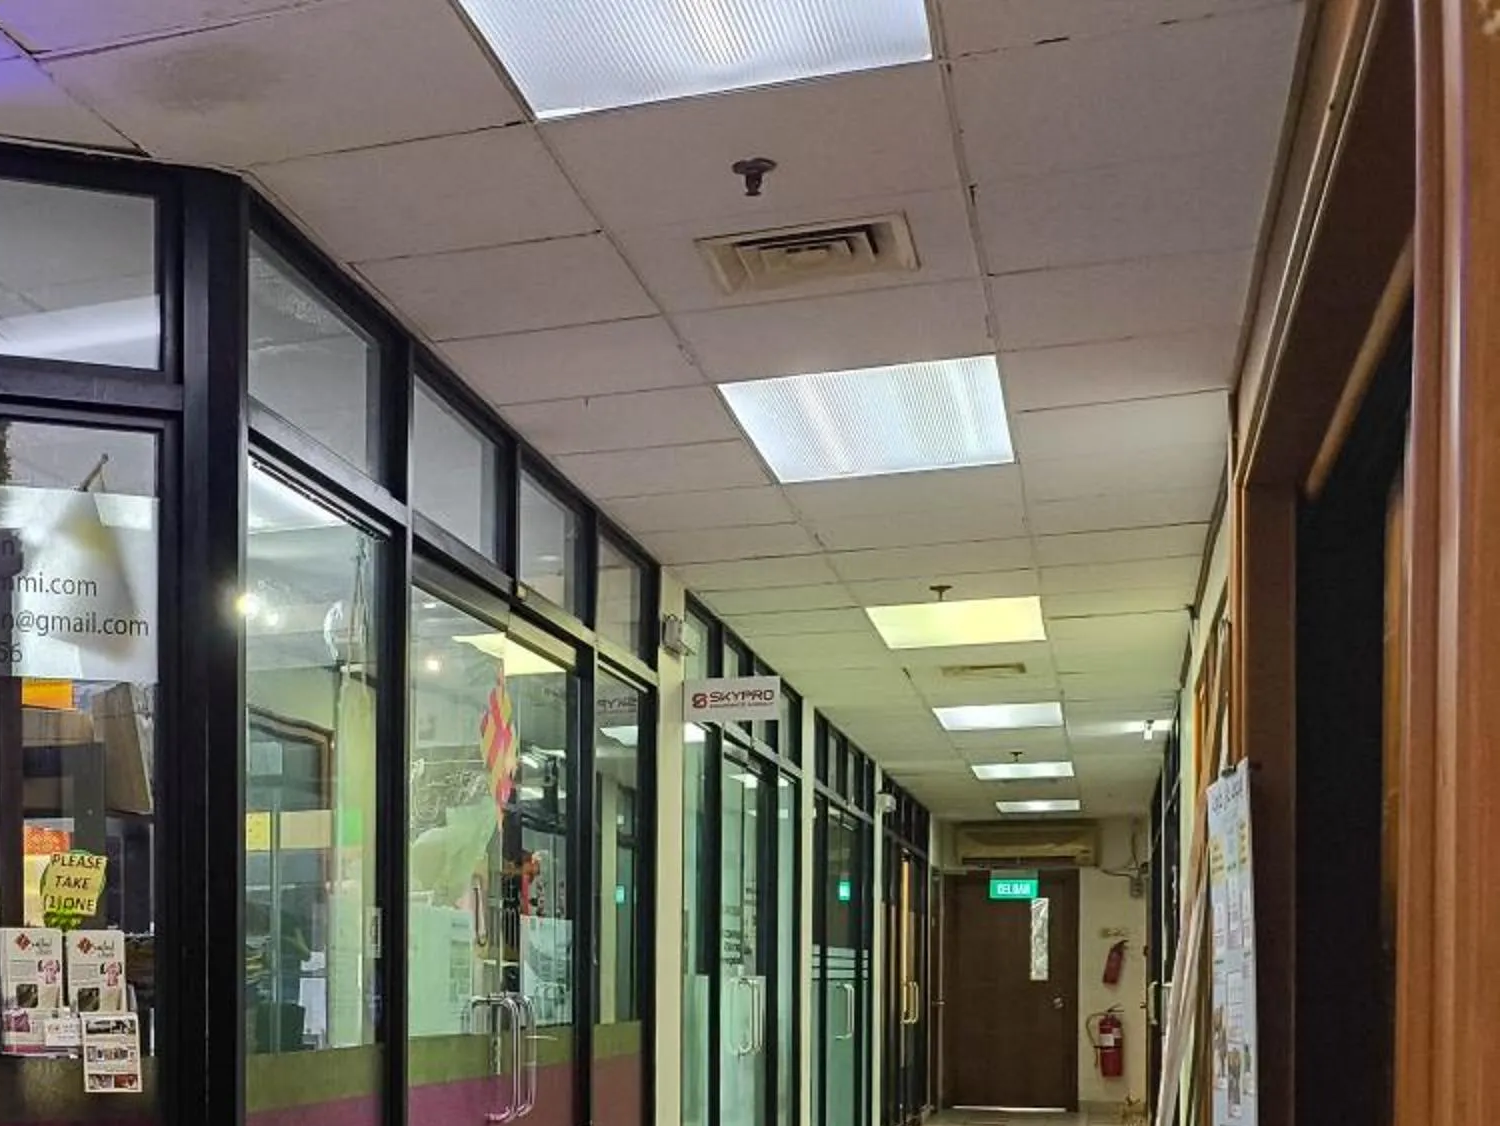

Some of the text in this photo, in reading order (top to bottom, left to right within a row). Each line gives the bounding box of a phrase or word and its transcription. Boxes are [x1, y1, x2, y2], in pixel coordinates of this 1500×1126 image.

[709, 689, 775, 703] SKYPRO
[51, 853, 104, 869] PLEASE
[54, 874, 92, 890] TAKE
